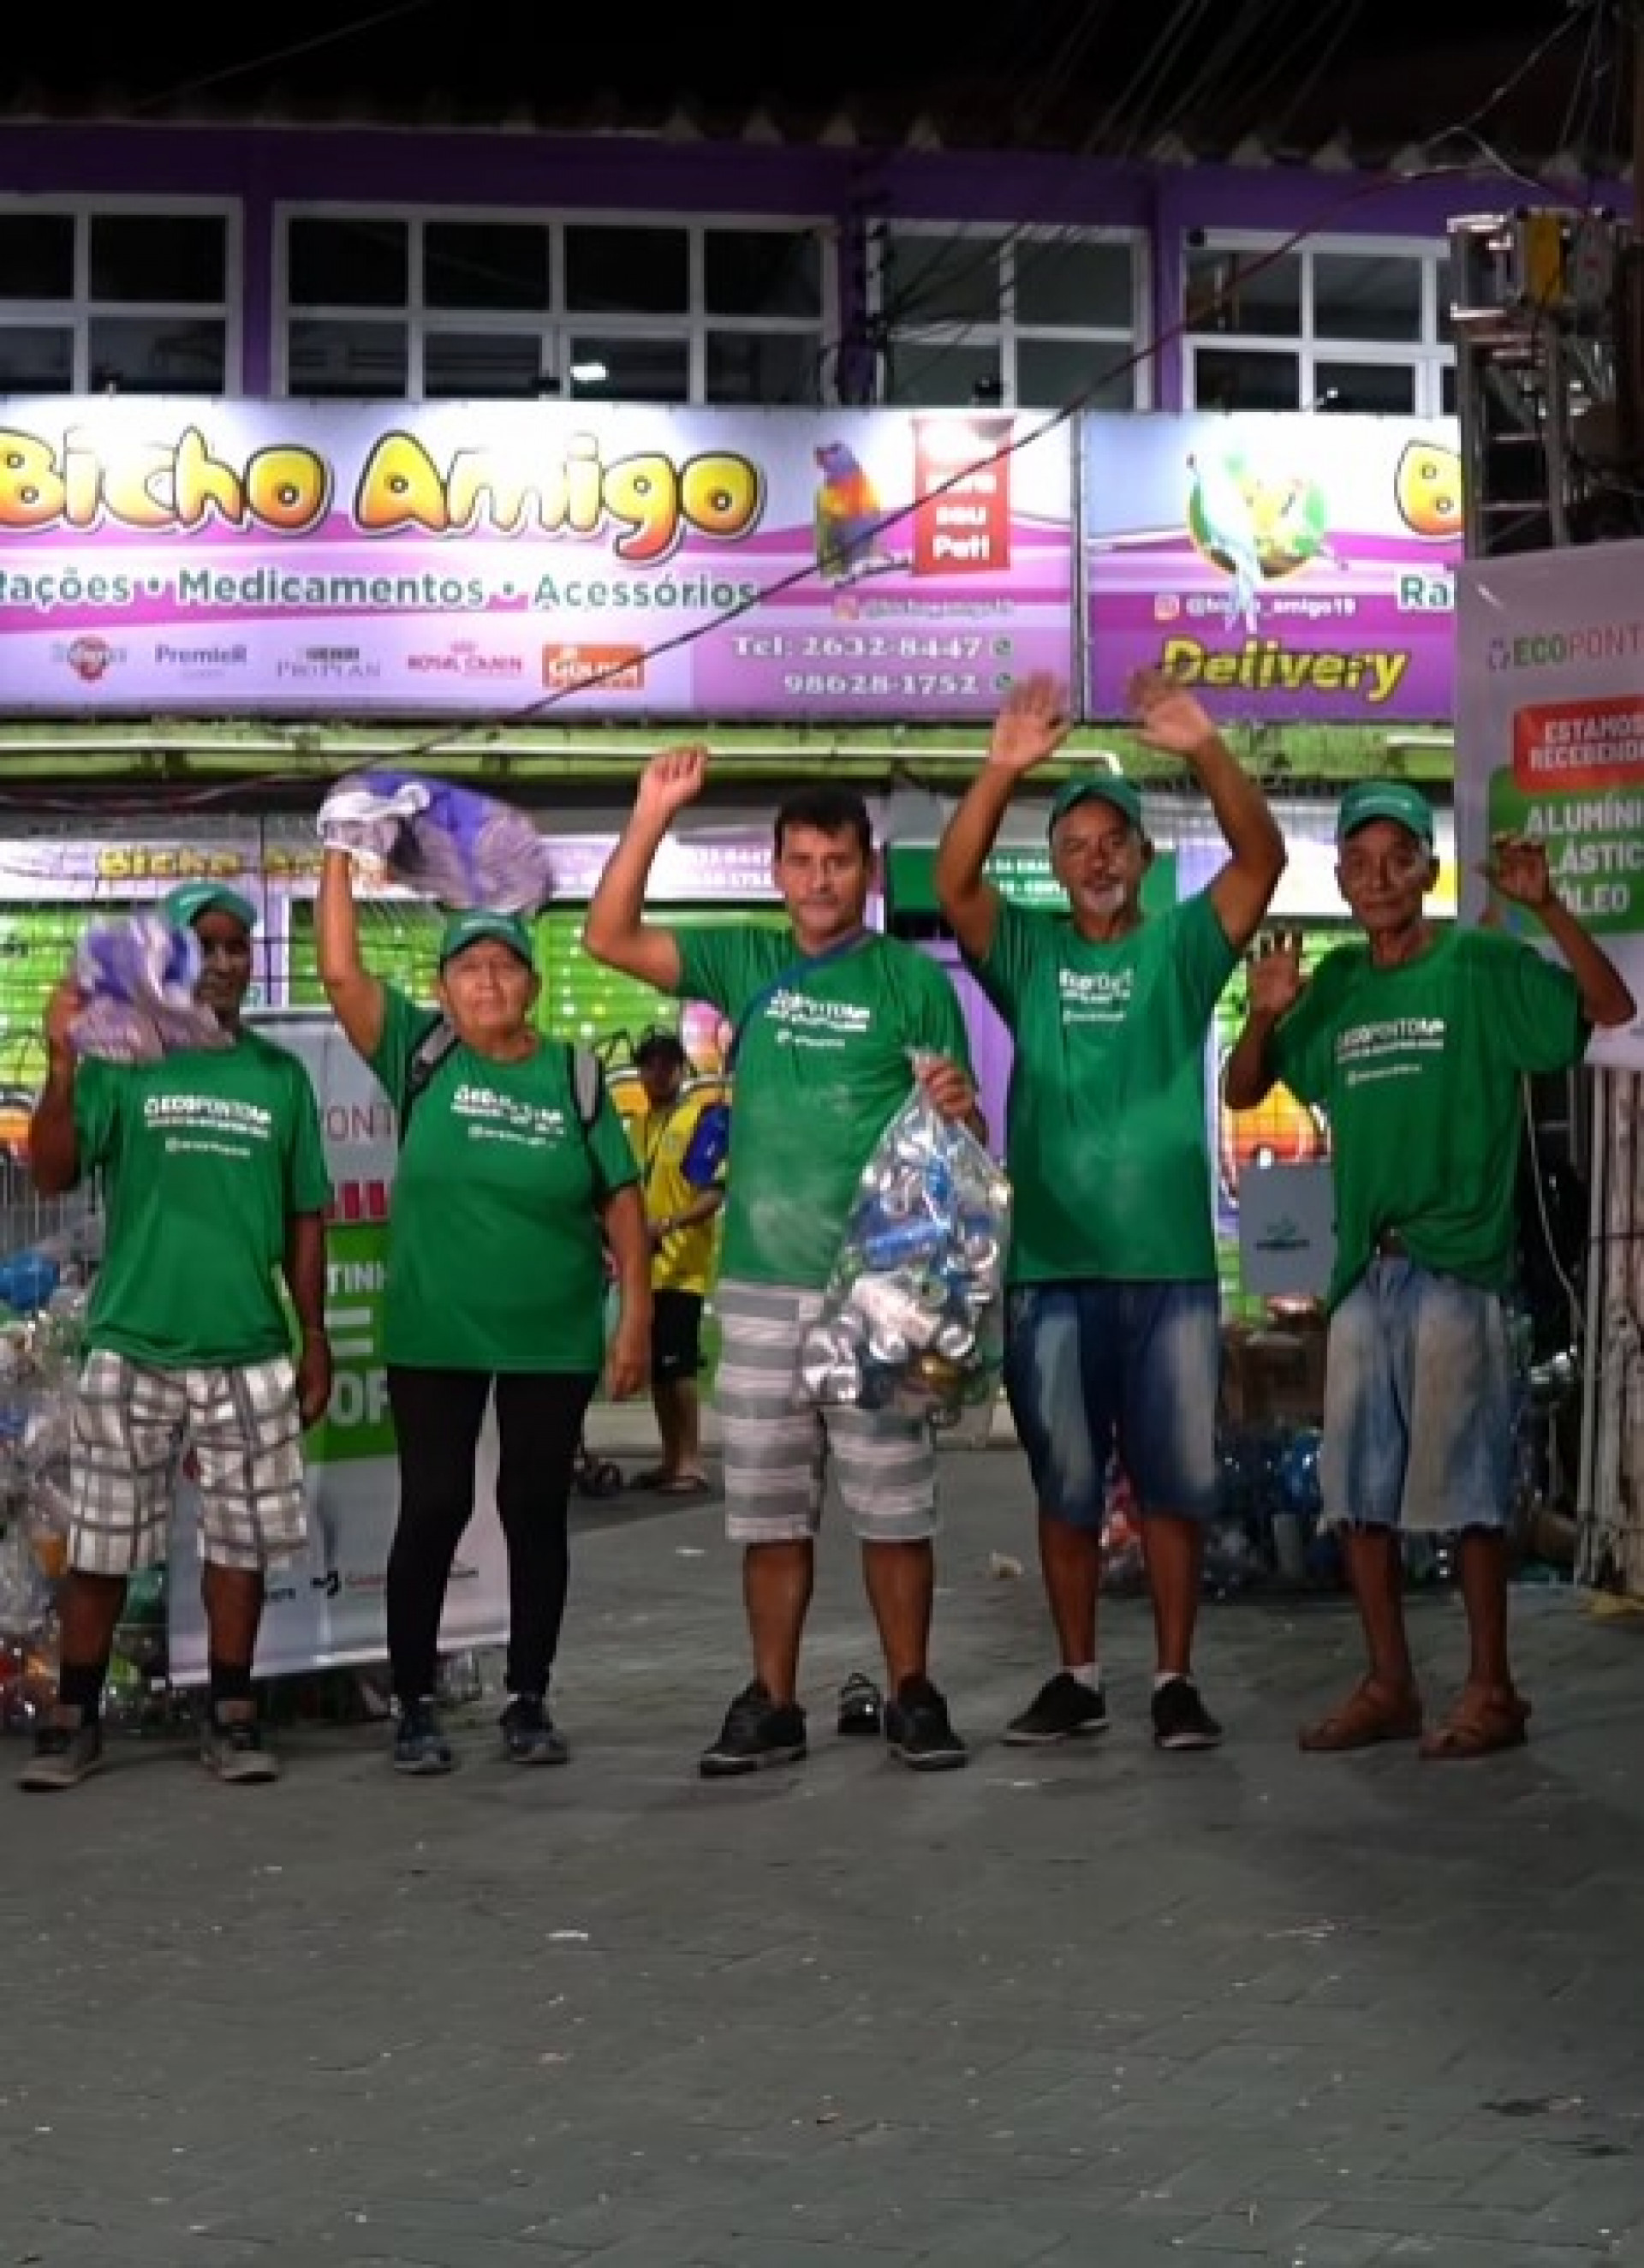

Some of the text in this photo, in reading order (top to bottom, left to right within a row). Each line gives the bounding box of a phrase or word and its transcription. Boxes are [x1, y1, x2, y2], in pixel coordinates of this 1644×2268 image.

[0, 423, 765, 566] Bicho Amigo
[178, 565, 485, 605] Medicamentos
[533, 572, 757, 610] Acessórios
[1160, 637, 1409, 703] Delivery
